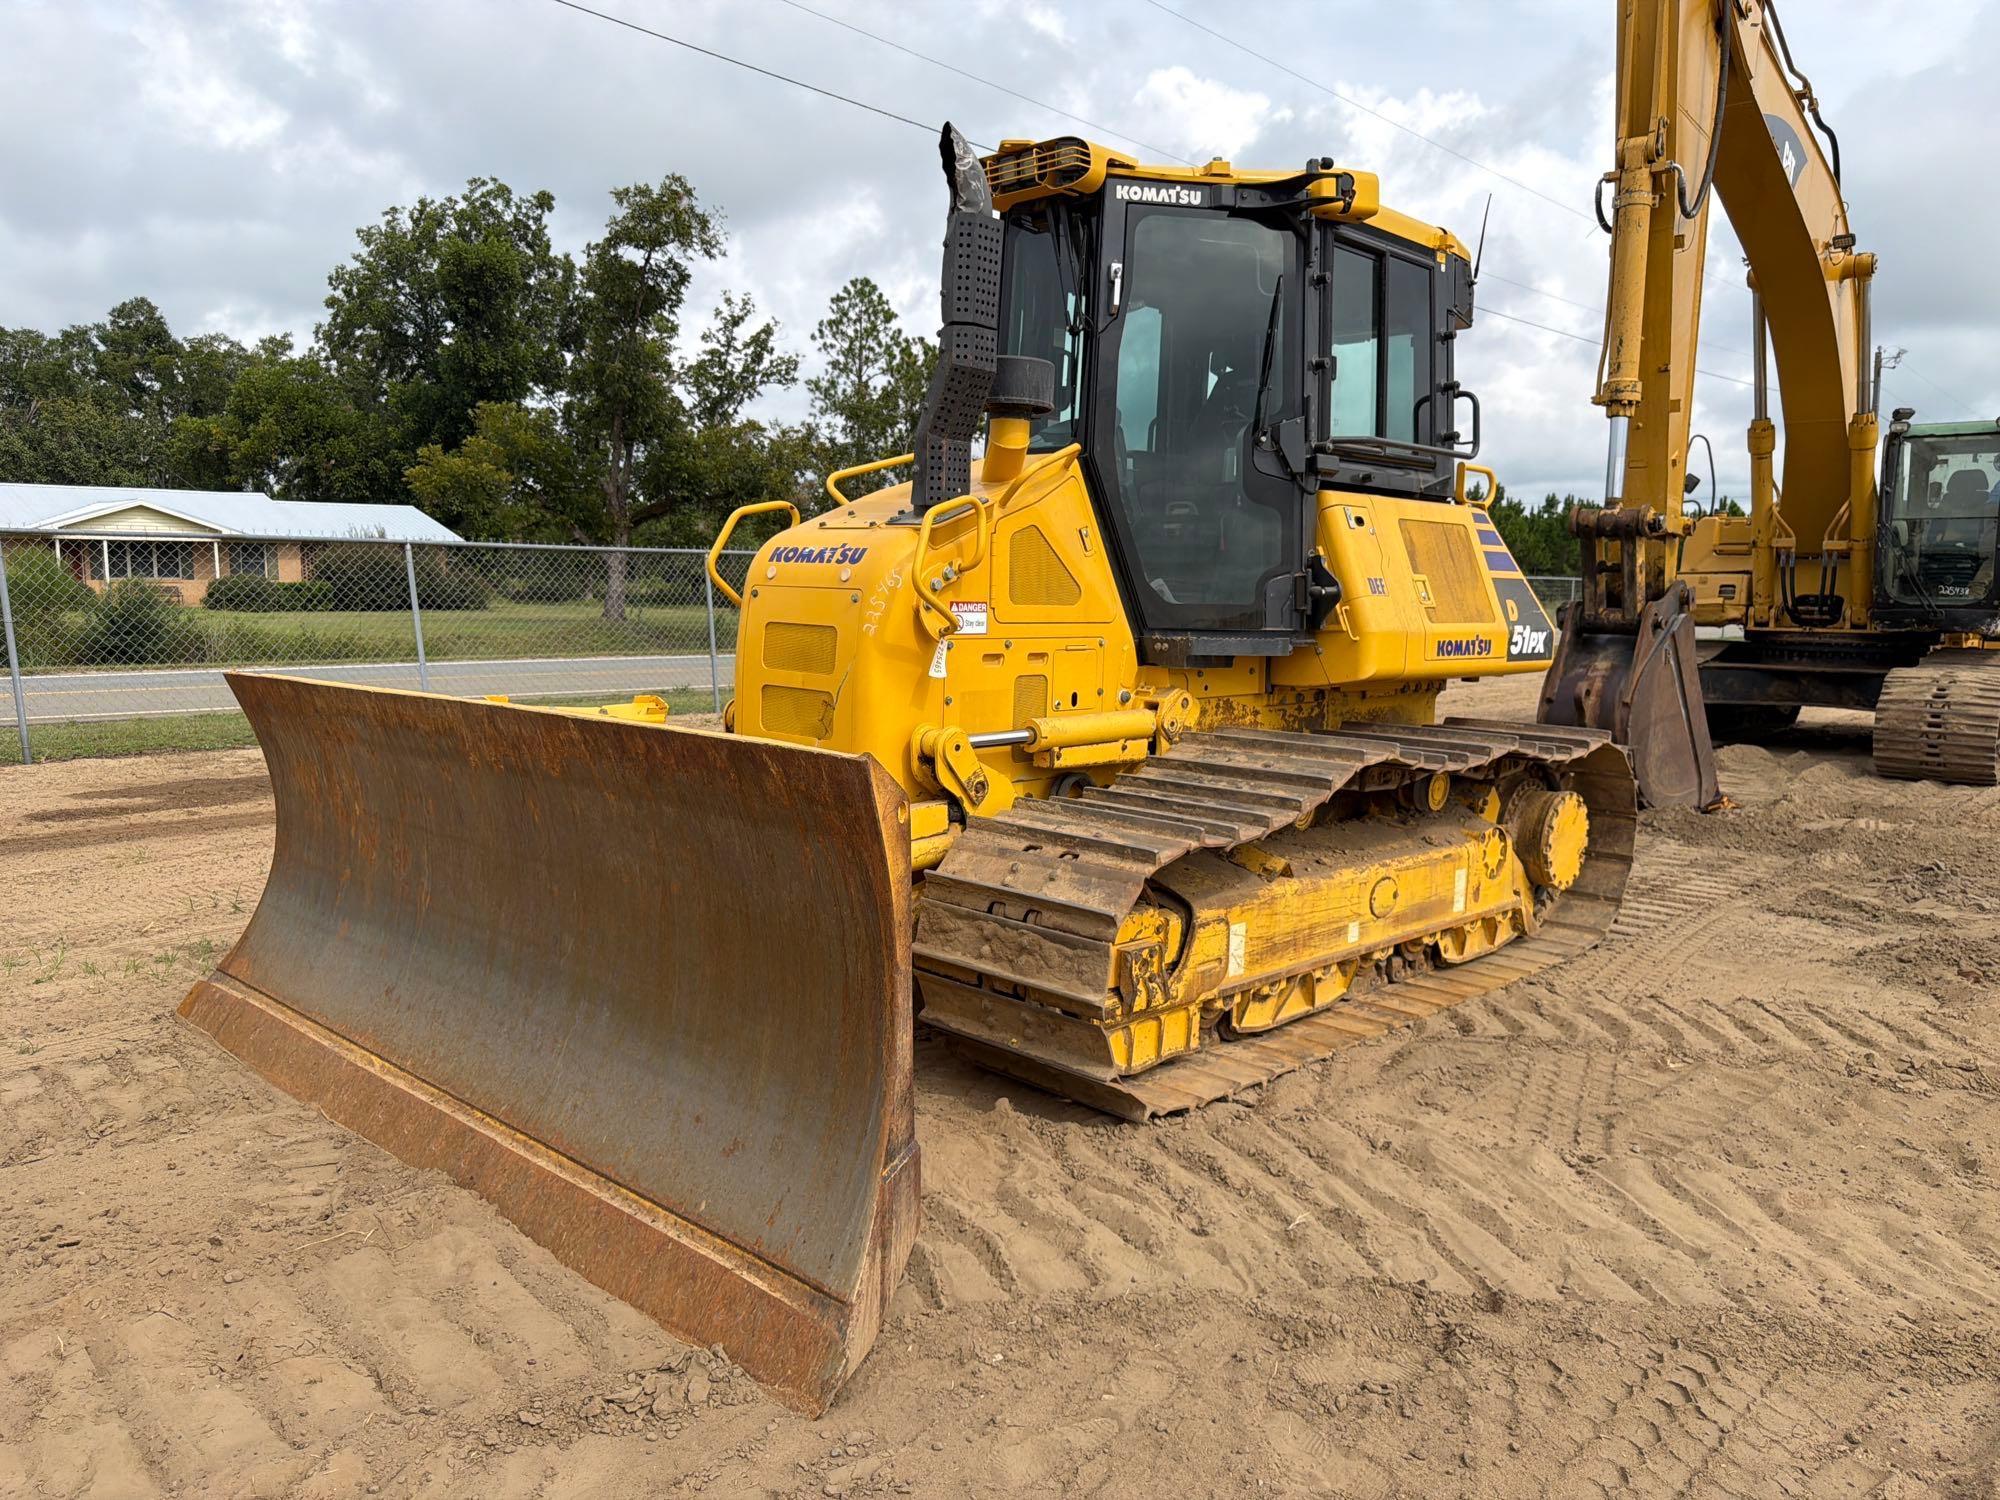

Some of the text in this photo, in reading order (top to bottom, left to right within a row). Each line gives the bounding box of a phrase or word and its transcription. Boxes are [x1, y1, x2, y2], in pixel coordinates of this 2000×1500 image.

[1116, 185, 1202, 205] KOMATSU
[768, 543, 868, 564] KOMATSU
[1367, 577, 1385, 594] DEF
[958, 602, 987, 612] DANGER
[1506, 599, 1518, 621] D
[1437, 634, 1492, 656] KOMATSU
[1510, 625, 1547, 655] 51PX
